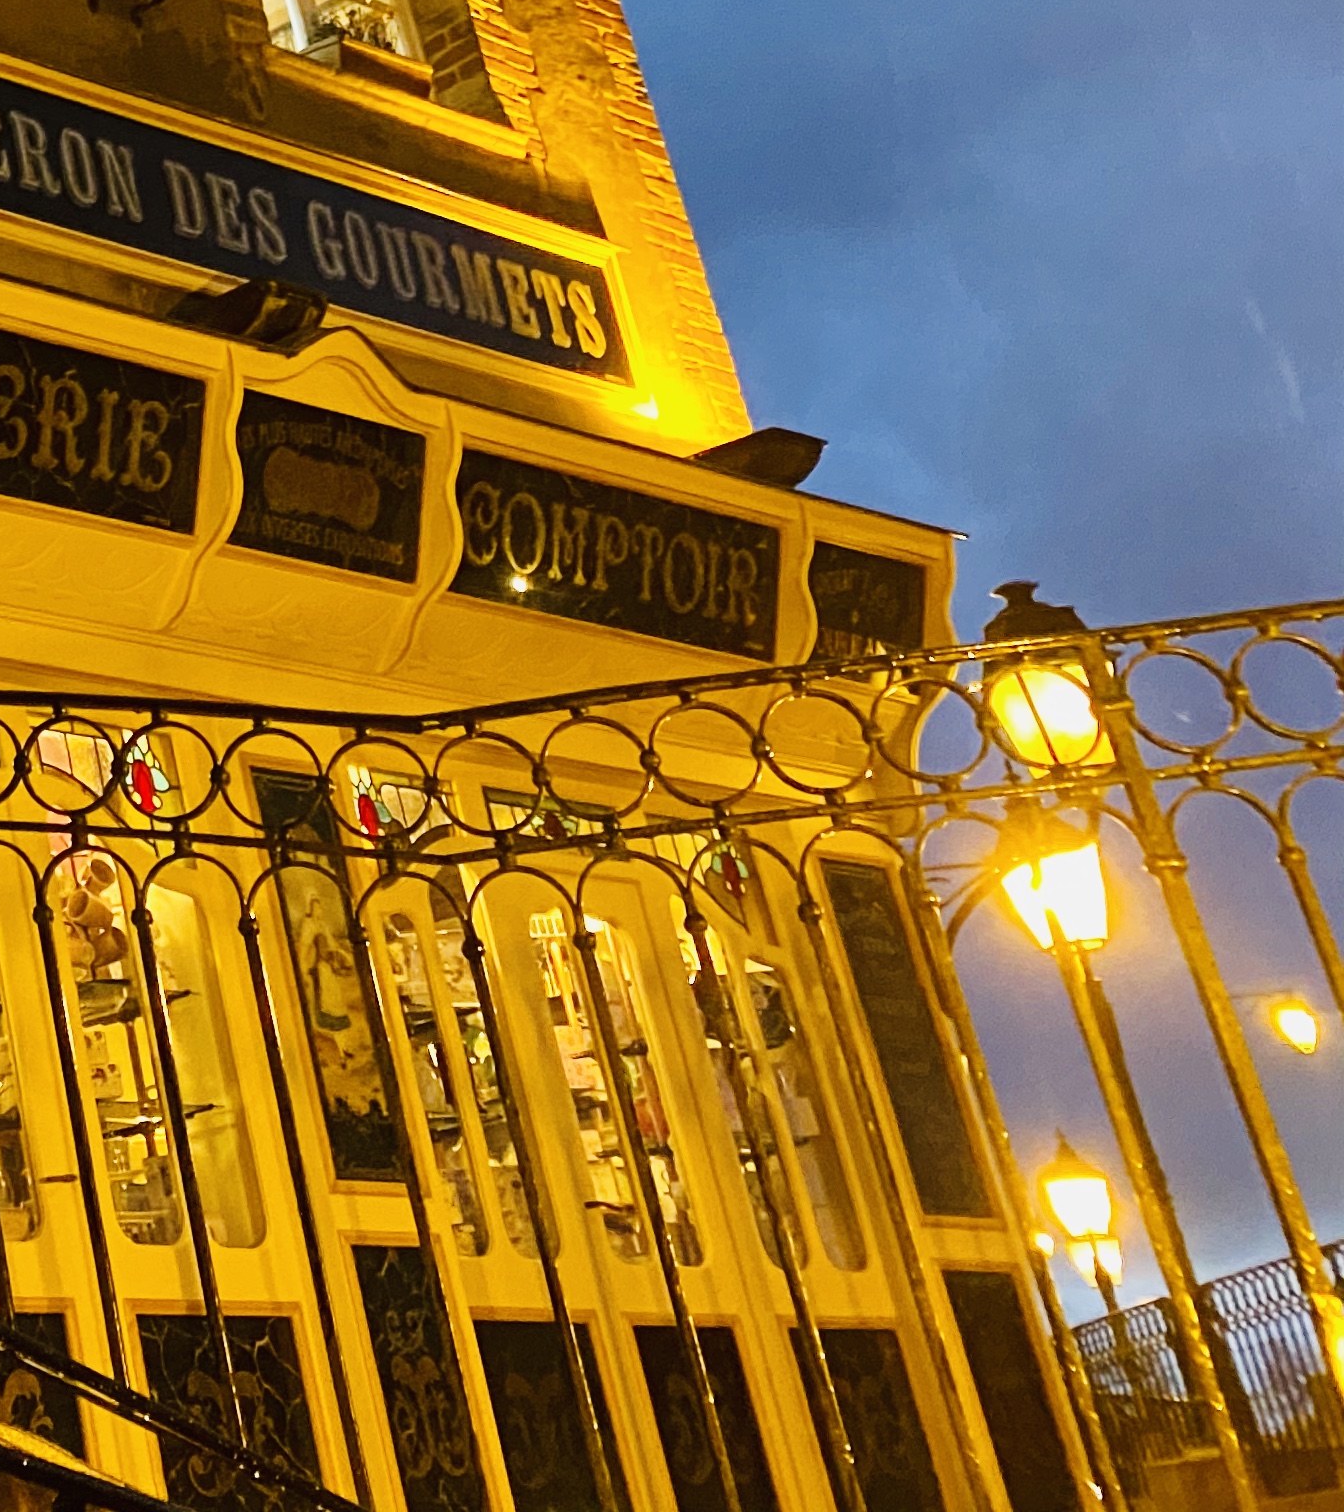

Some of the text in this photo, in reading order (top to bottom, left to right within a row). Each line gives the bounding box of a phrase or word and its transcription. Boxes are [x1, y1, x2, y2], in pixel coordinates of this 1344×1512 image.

[162, 159, 287, 264] DES
[307, 200, 608, 359] GOURMETS
[462, 480, 759, 626] COMPTOIR
